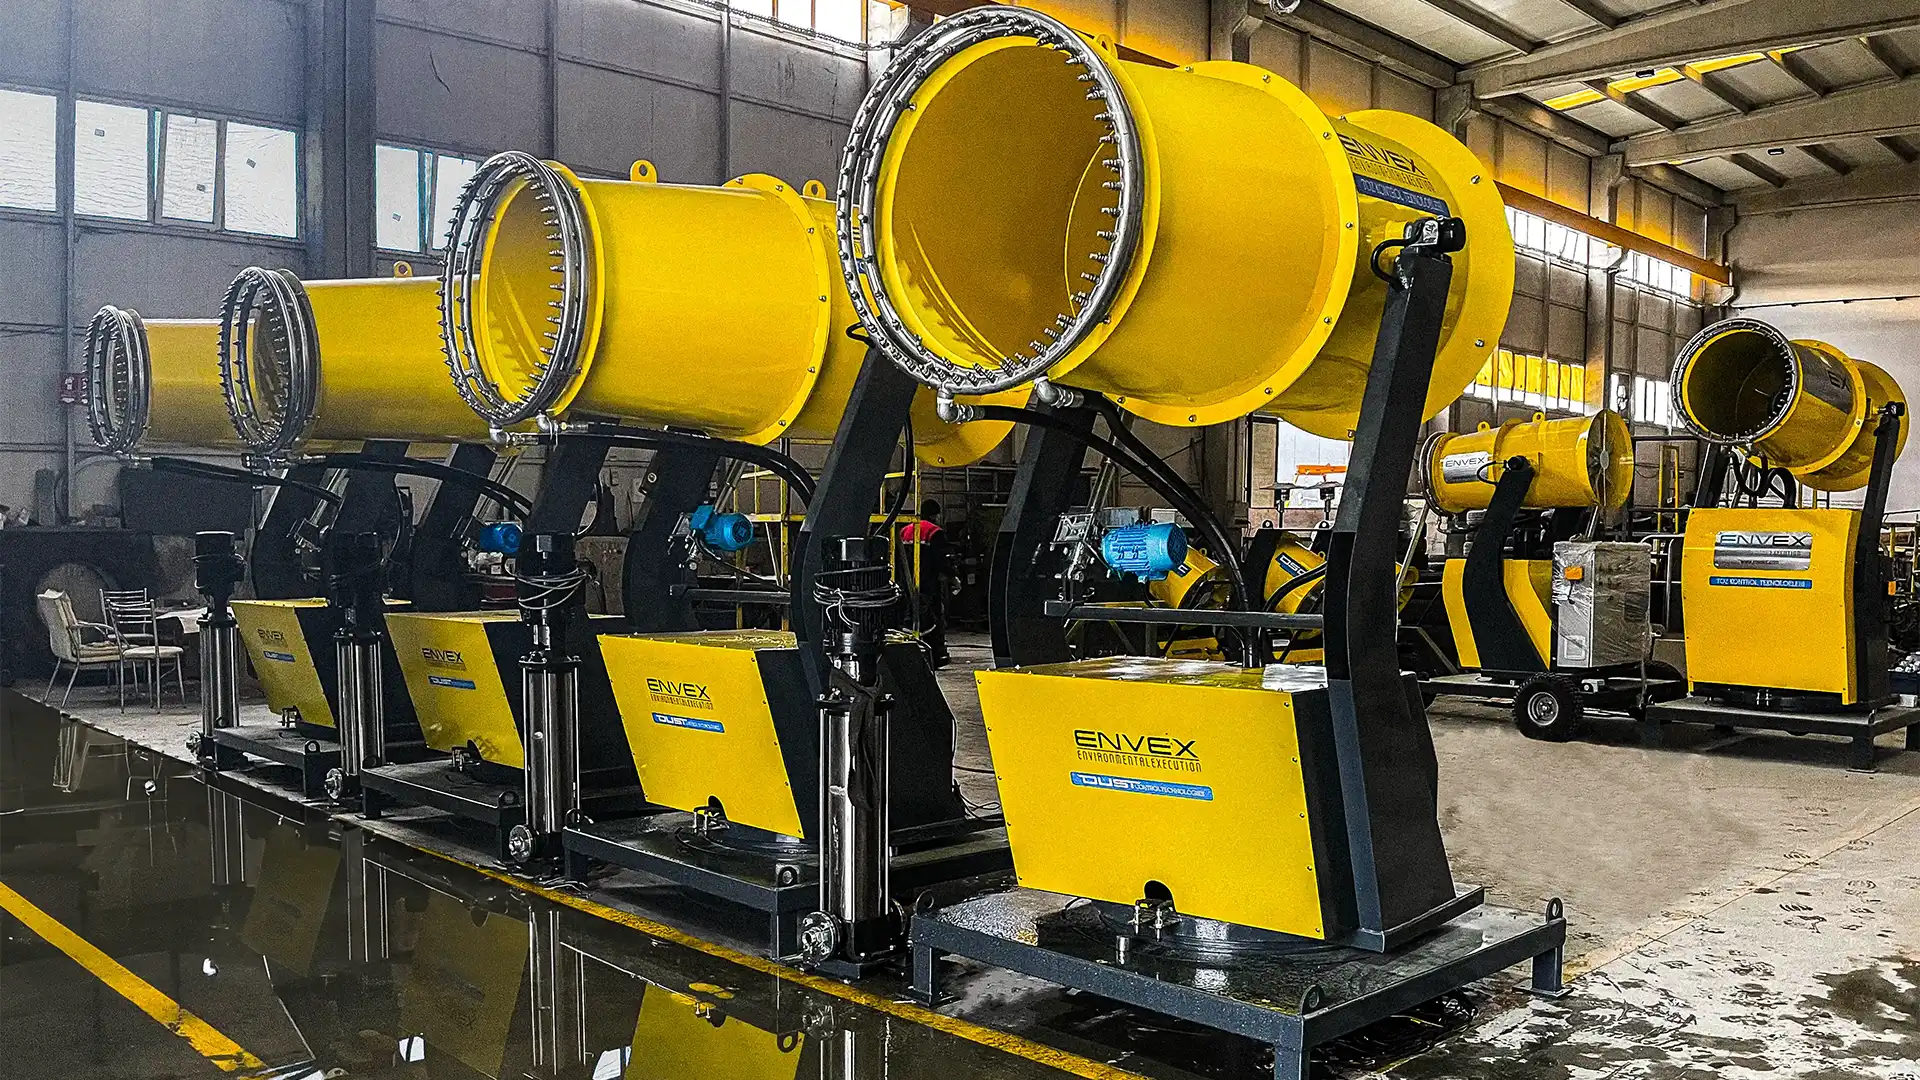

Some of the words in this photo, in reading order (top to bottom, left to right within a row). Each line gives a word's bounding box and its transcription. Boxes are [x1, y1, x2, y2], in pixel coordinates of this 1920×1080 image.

[1336, 132, 1426, 176] ENVEX
[1445, 457, 1485, 467] ENVEX
[1720, 534, 1808, 547] ENVEX
[421, 647, 464, 664] ENVEX
[646, 678, 711, 700] ENVEX
[655, 714, 688, 727] DUST
[1074, 729, 1199, 759] ENVEX
[1077, 773, 1141, 790] DUST
